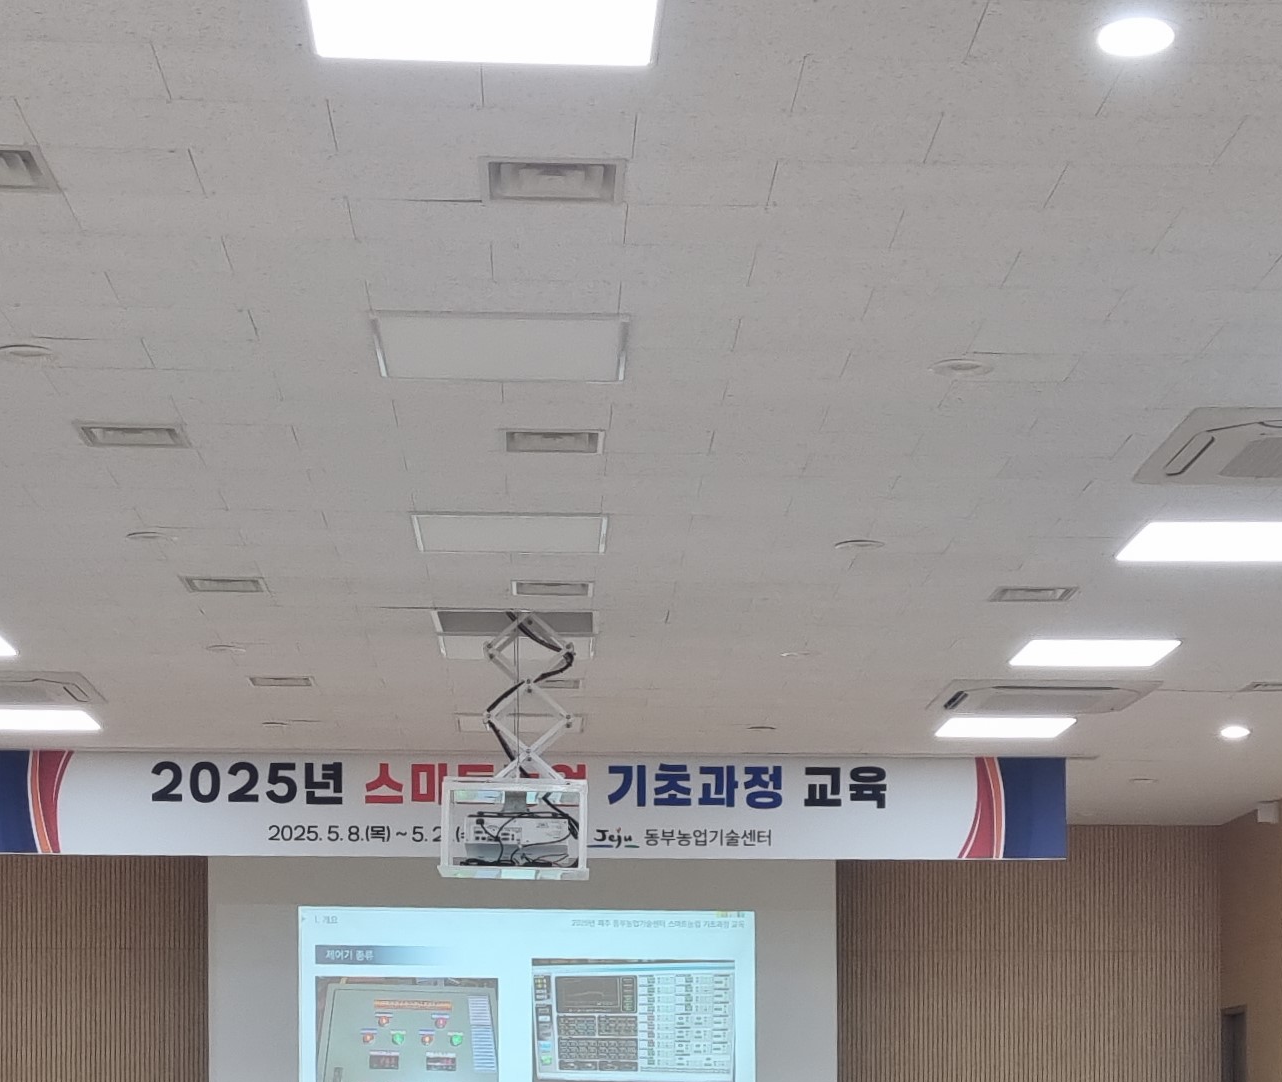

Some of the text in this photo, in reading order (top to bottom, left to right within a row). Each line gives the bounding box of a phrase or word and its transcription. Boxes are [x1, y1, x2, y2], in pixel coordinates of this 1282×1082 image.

[150, 761, 343, 805] 2025년
[607, 763, 783, 809] 기초과정
[804, 766, 887, 809] 교육
[593, 828, 634, 849] Jeju
[644, 828, 772, 847] 동부농업기술센터
[325, 949, 353, 961] 제어기
